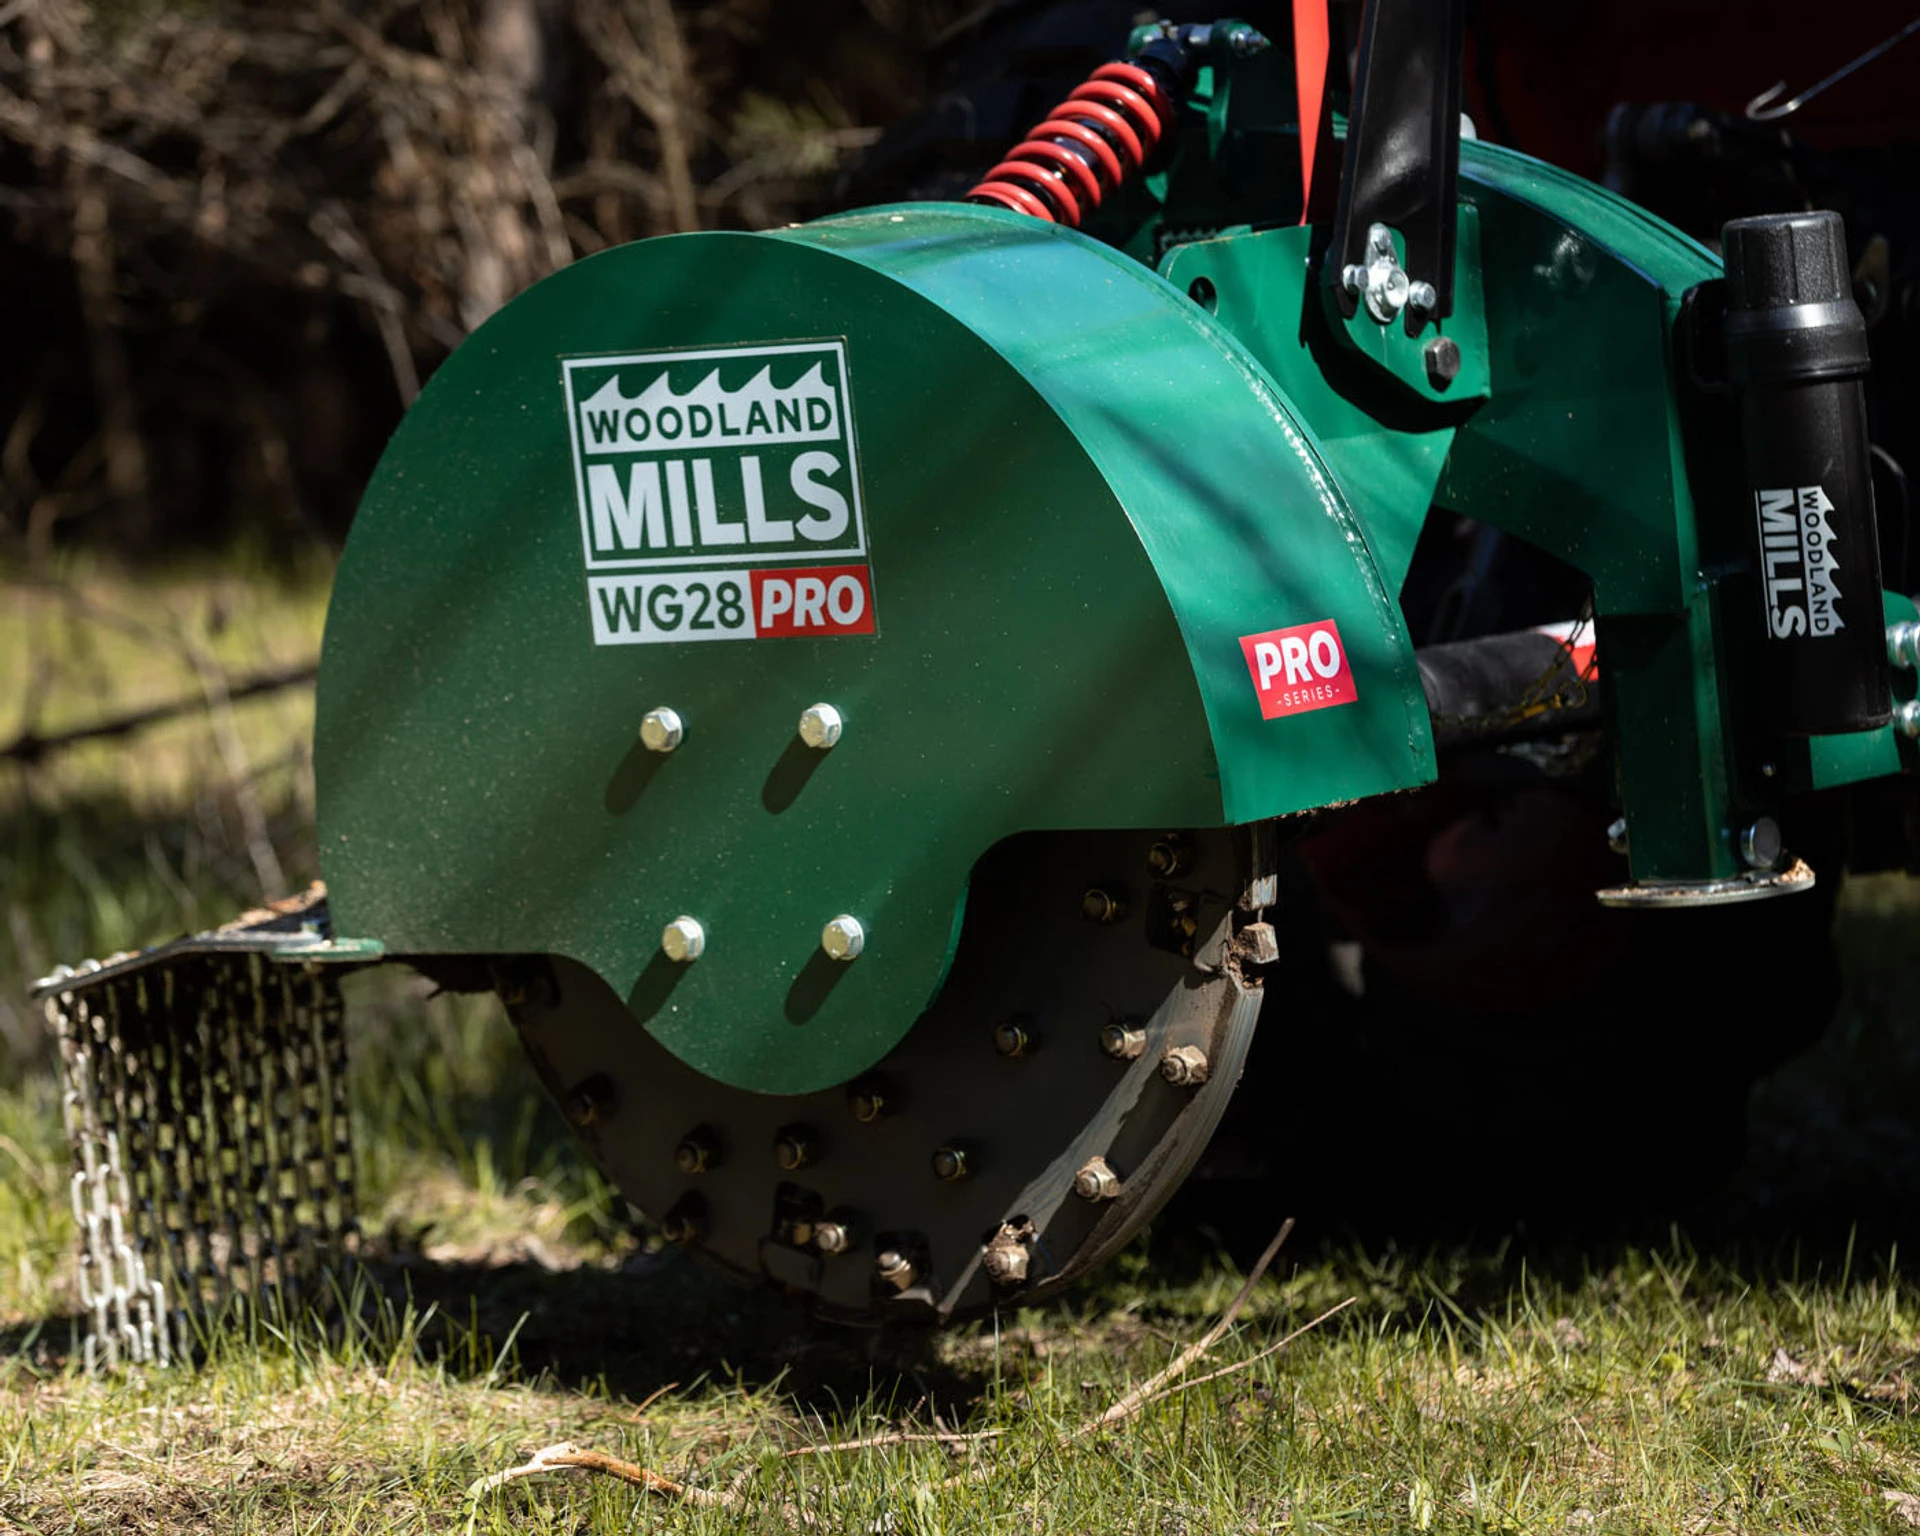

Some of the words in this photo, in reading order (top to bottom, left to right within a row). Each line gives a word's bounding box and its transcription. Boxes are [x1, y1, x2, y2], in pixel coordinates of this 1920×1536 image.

[587, 397, 832, 444] WOODLAND
[586, 450, 849, 551] MILLS
[1760, 488, 1807, 639] MILLS
[1803, 490, 1830, 632] WOODLAND
[598, 580, 746, 634] WG28
[761, 574, 865, 629] PRO
[1254, 629, 1341, 691] PRO
